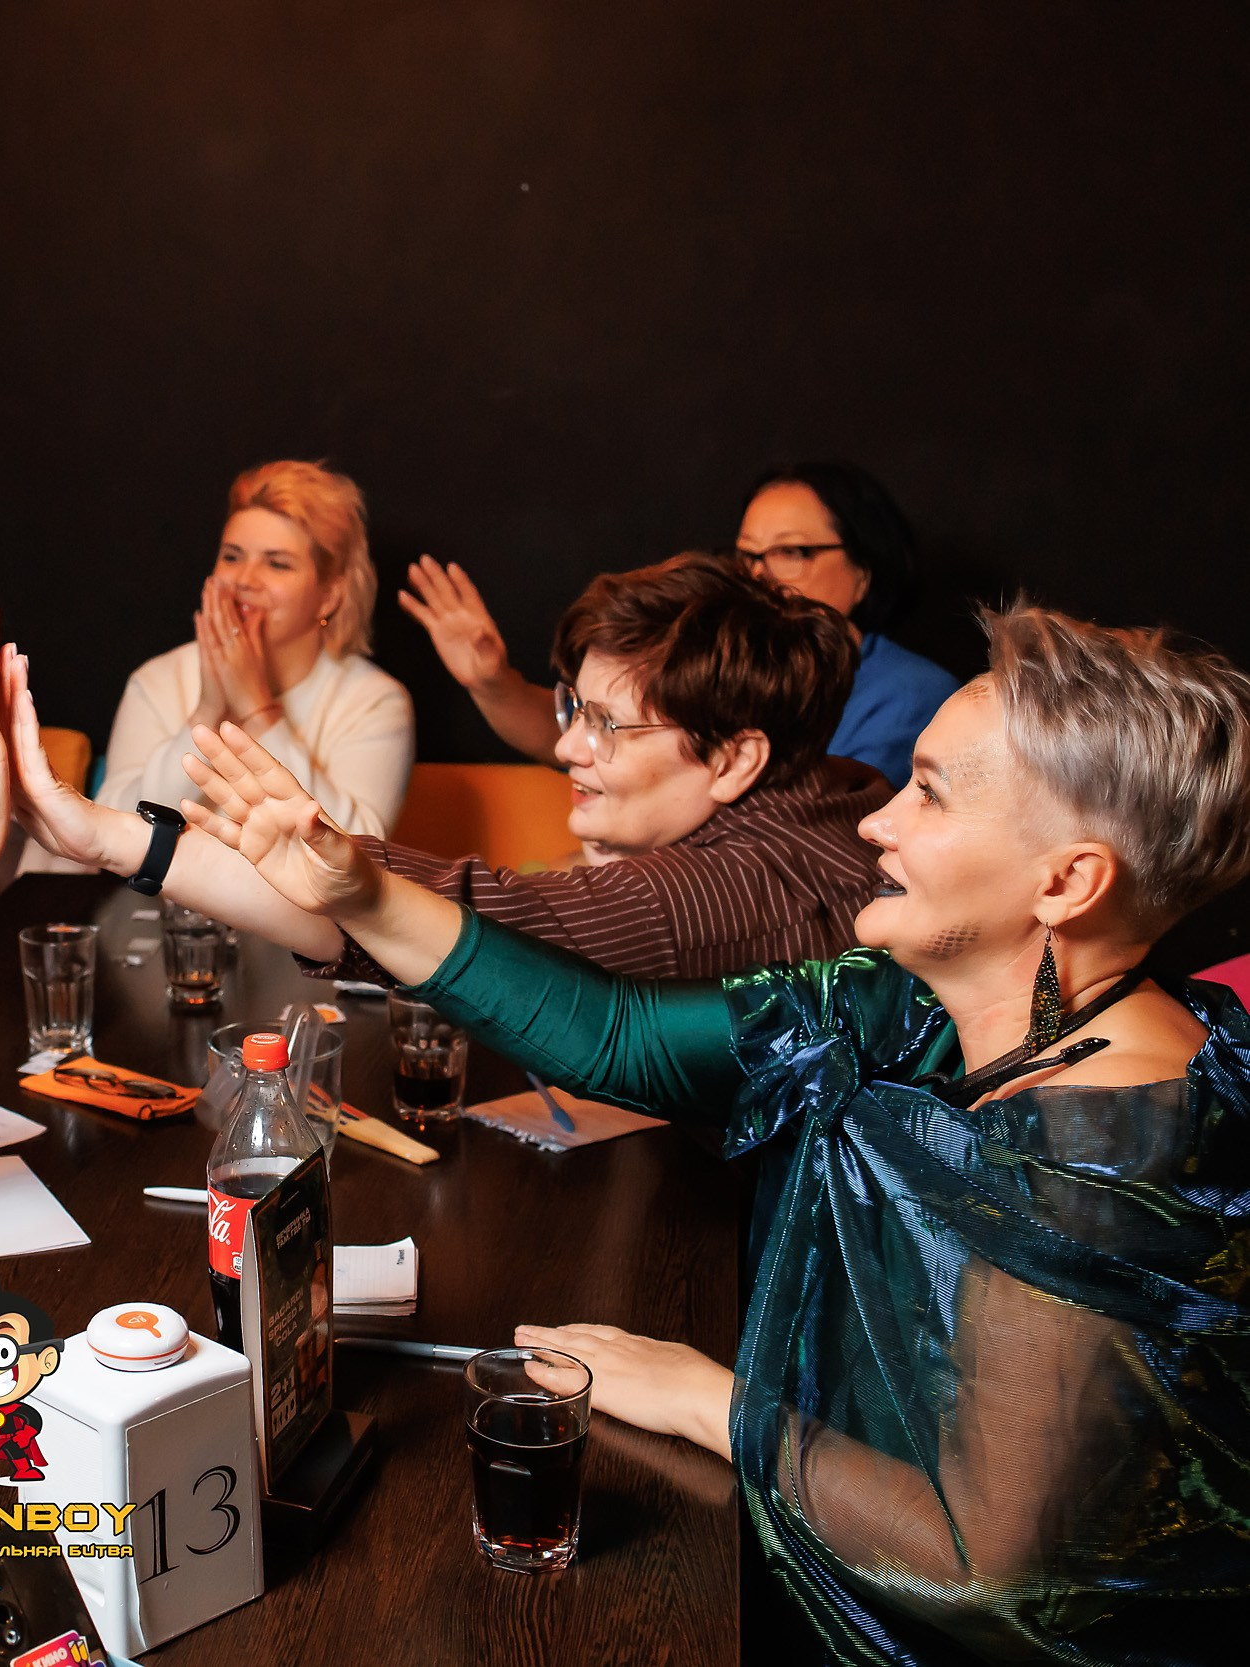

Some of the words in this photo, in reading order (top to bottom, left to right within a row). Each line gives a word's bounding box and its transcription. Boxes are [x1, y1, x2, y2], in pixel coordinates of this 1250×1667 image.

[268, 1287, 304, 1328] BACARDI
[268, 1307, 297, 1341] SPICED
[275, 1321, 297, 1347] COLA
[270, 1365, 295, 1410] 2+1
[137, 1465, 241, 1586] 13
[32, 1647, 68, 1667] КИНО
